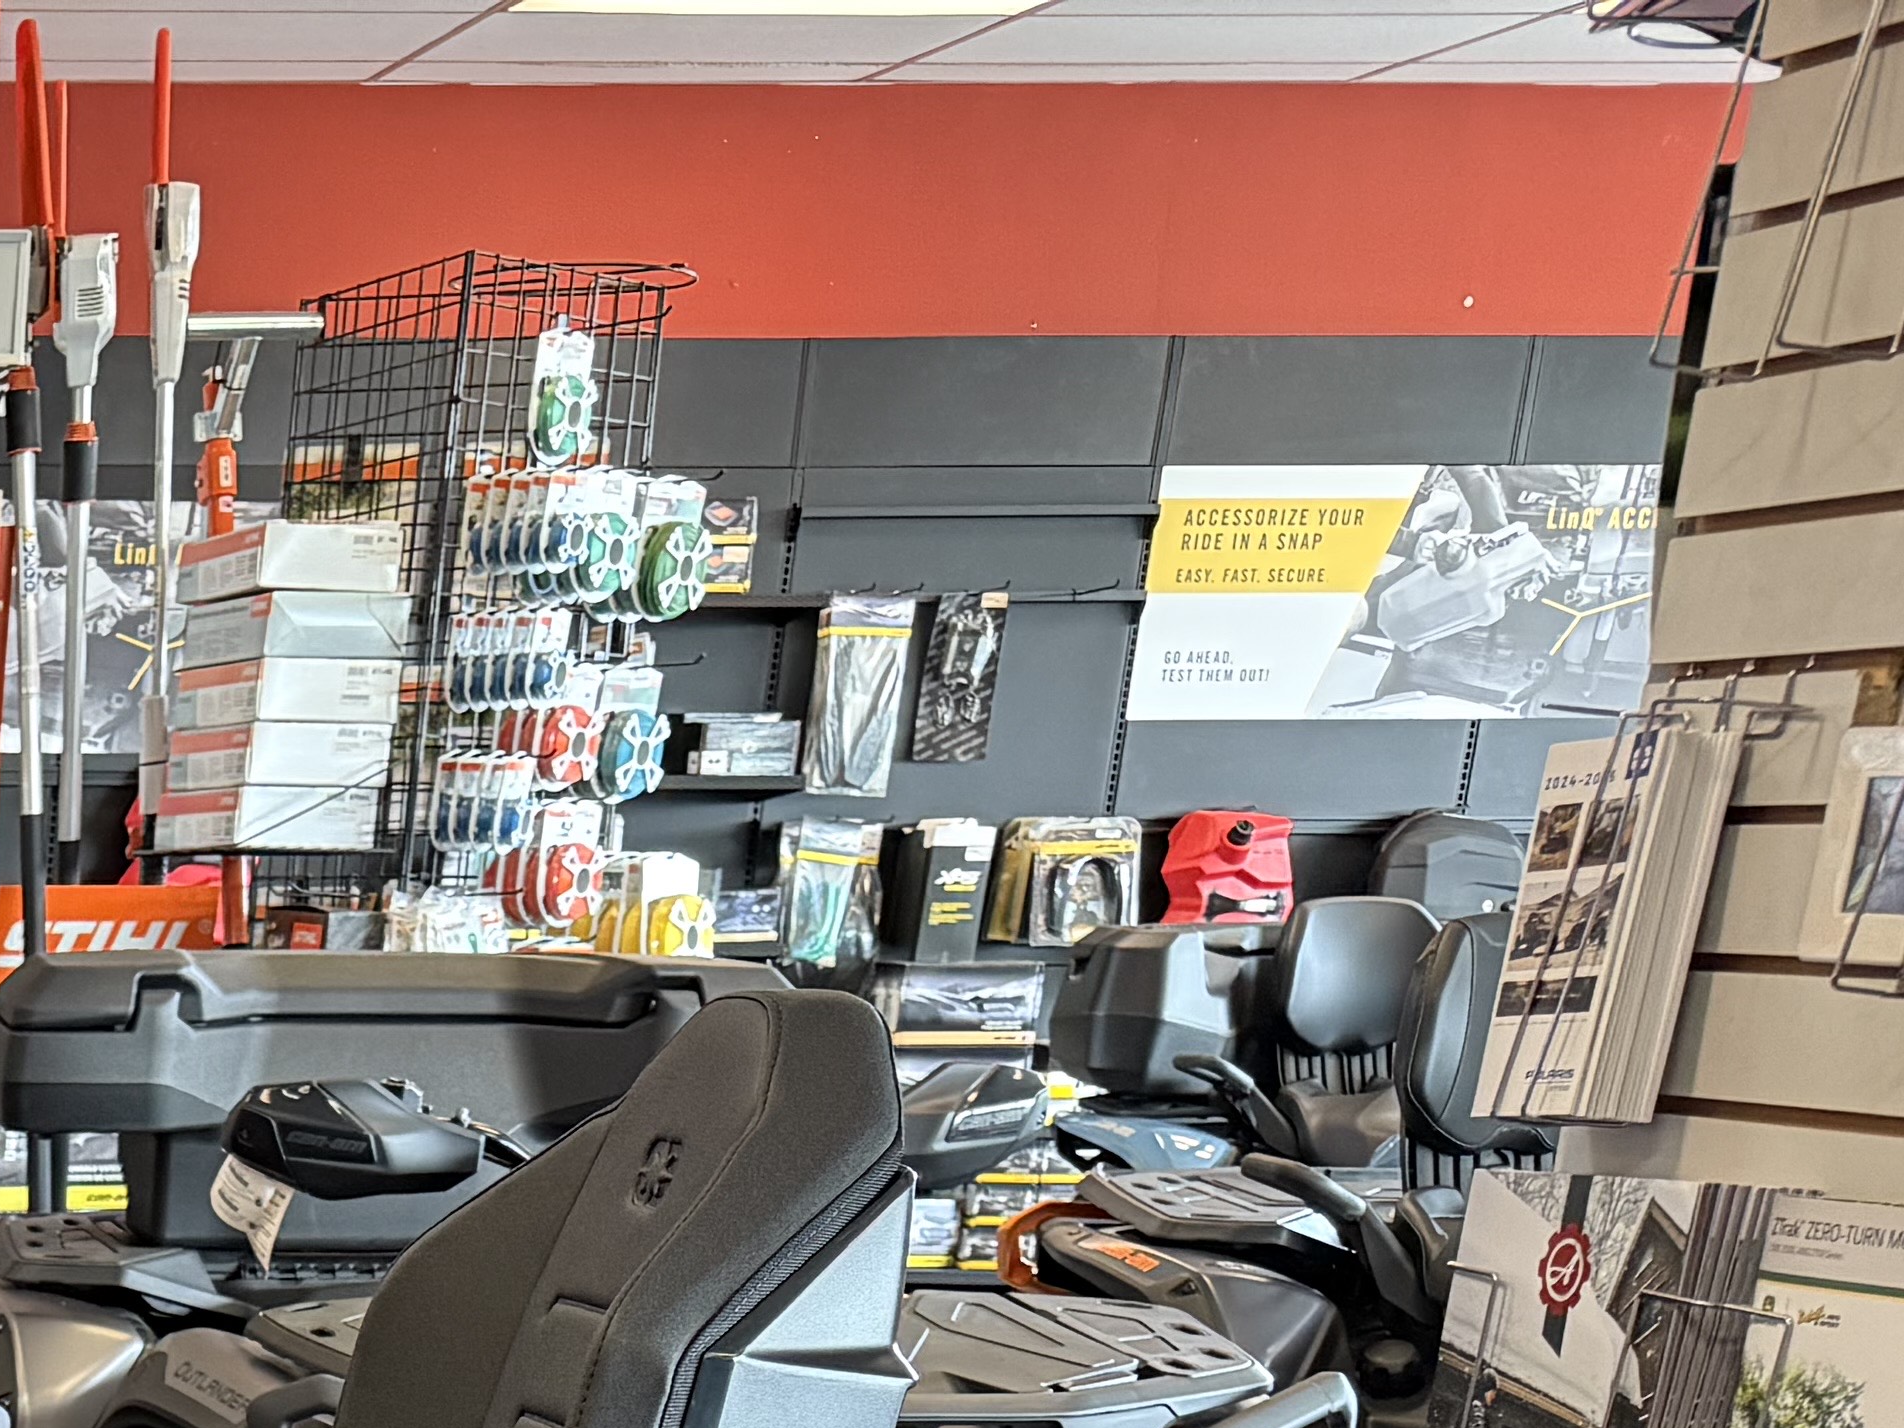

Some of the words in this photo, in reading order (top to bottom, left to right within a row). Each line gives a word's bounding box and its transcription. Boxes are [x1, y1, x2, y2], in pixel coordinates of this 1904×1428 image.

[1183, 508, 1310, 528] ACCESSORIZE
[1318, 508, 1365, 526] YOUR
[1607, 505, 1658, 529] ACC
[1180, 532, 1223, 551] RIDE
[1232, 532, 1253, 551] IN
[1258, 532, 1270, 550] A
[1276, 532, 1324, 551] SNAP
[1175, 568, 1216, 583] EASY.
[1222, 568, 1261, 583] FAST.
[1163, 650, 1186, 665] GO
[1161, 668, 1193, 682] TEST
[1199, 668, 1233, 682] THEM
[1239, 668, 1271, 683] OUT!
[1804, 1220, 1884, 1247] ZERO-TURN
